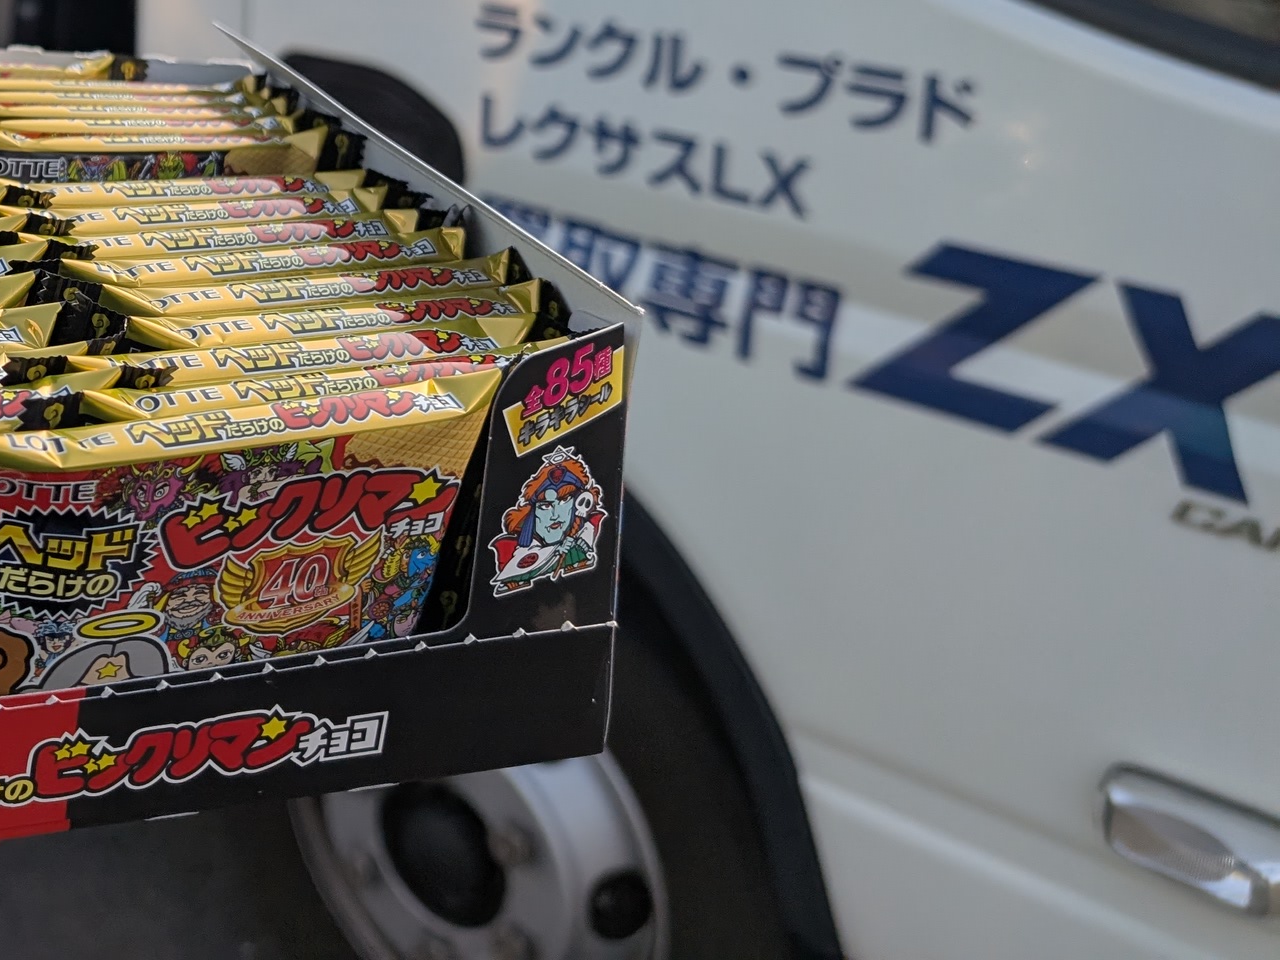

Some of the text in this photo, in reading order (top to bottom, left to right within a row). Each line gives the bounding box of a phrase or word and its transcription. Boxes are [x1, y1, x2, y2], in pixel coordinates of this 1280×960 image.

[476, 2, 978, 142] ランクル・プラド
[479, 94, 811, 219] レクサスLX
[847, 240, 1280, 503] ZX
[161, 469, 461, 571] ビックリマン
[390, 512, 444, 539] チョコ
[1170, 498, 1280, 554] CA
[237, 592, 342, 621] ANNIVERSARY
